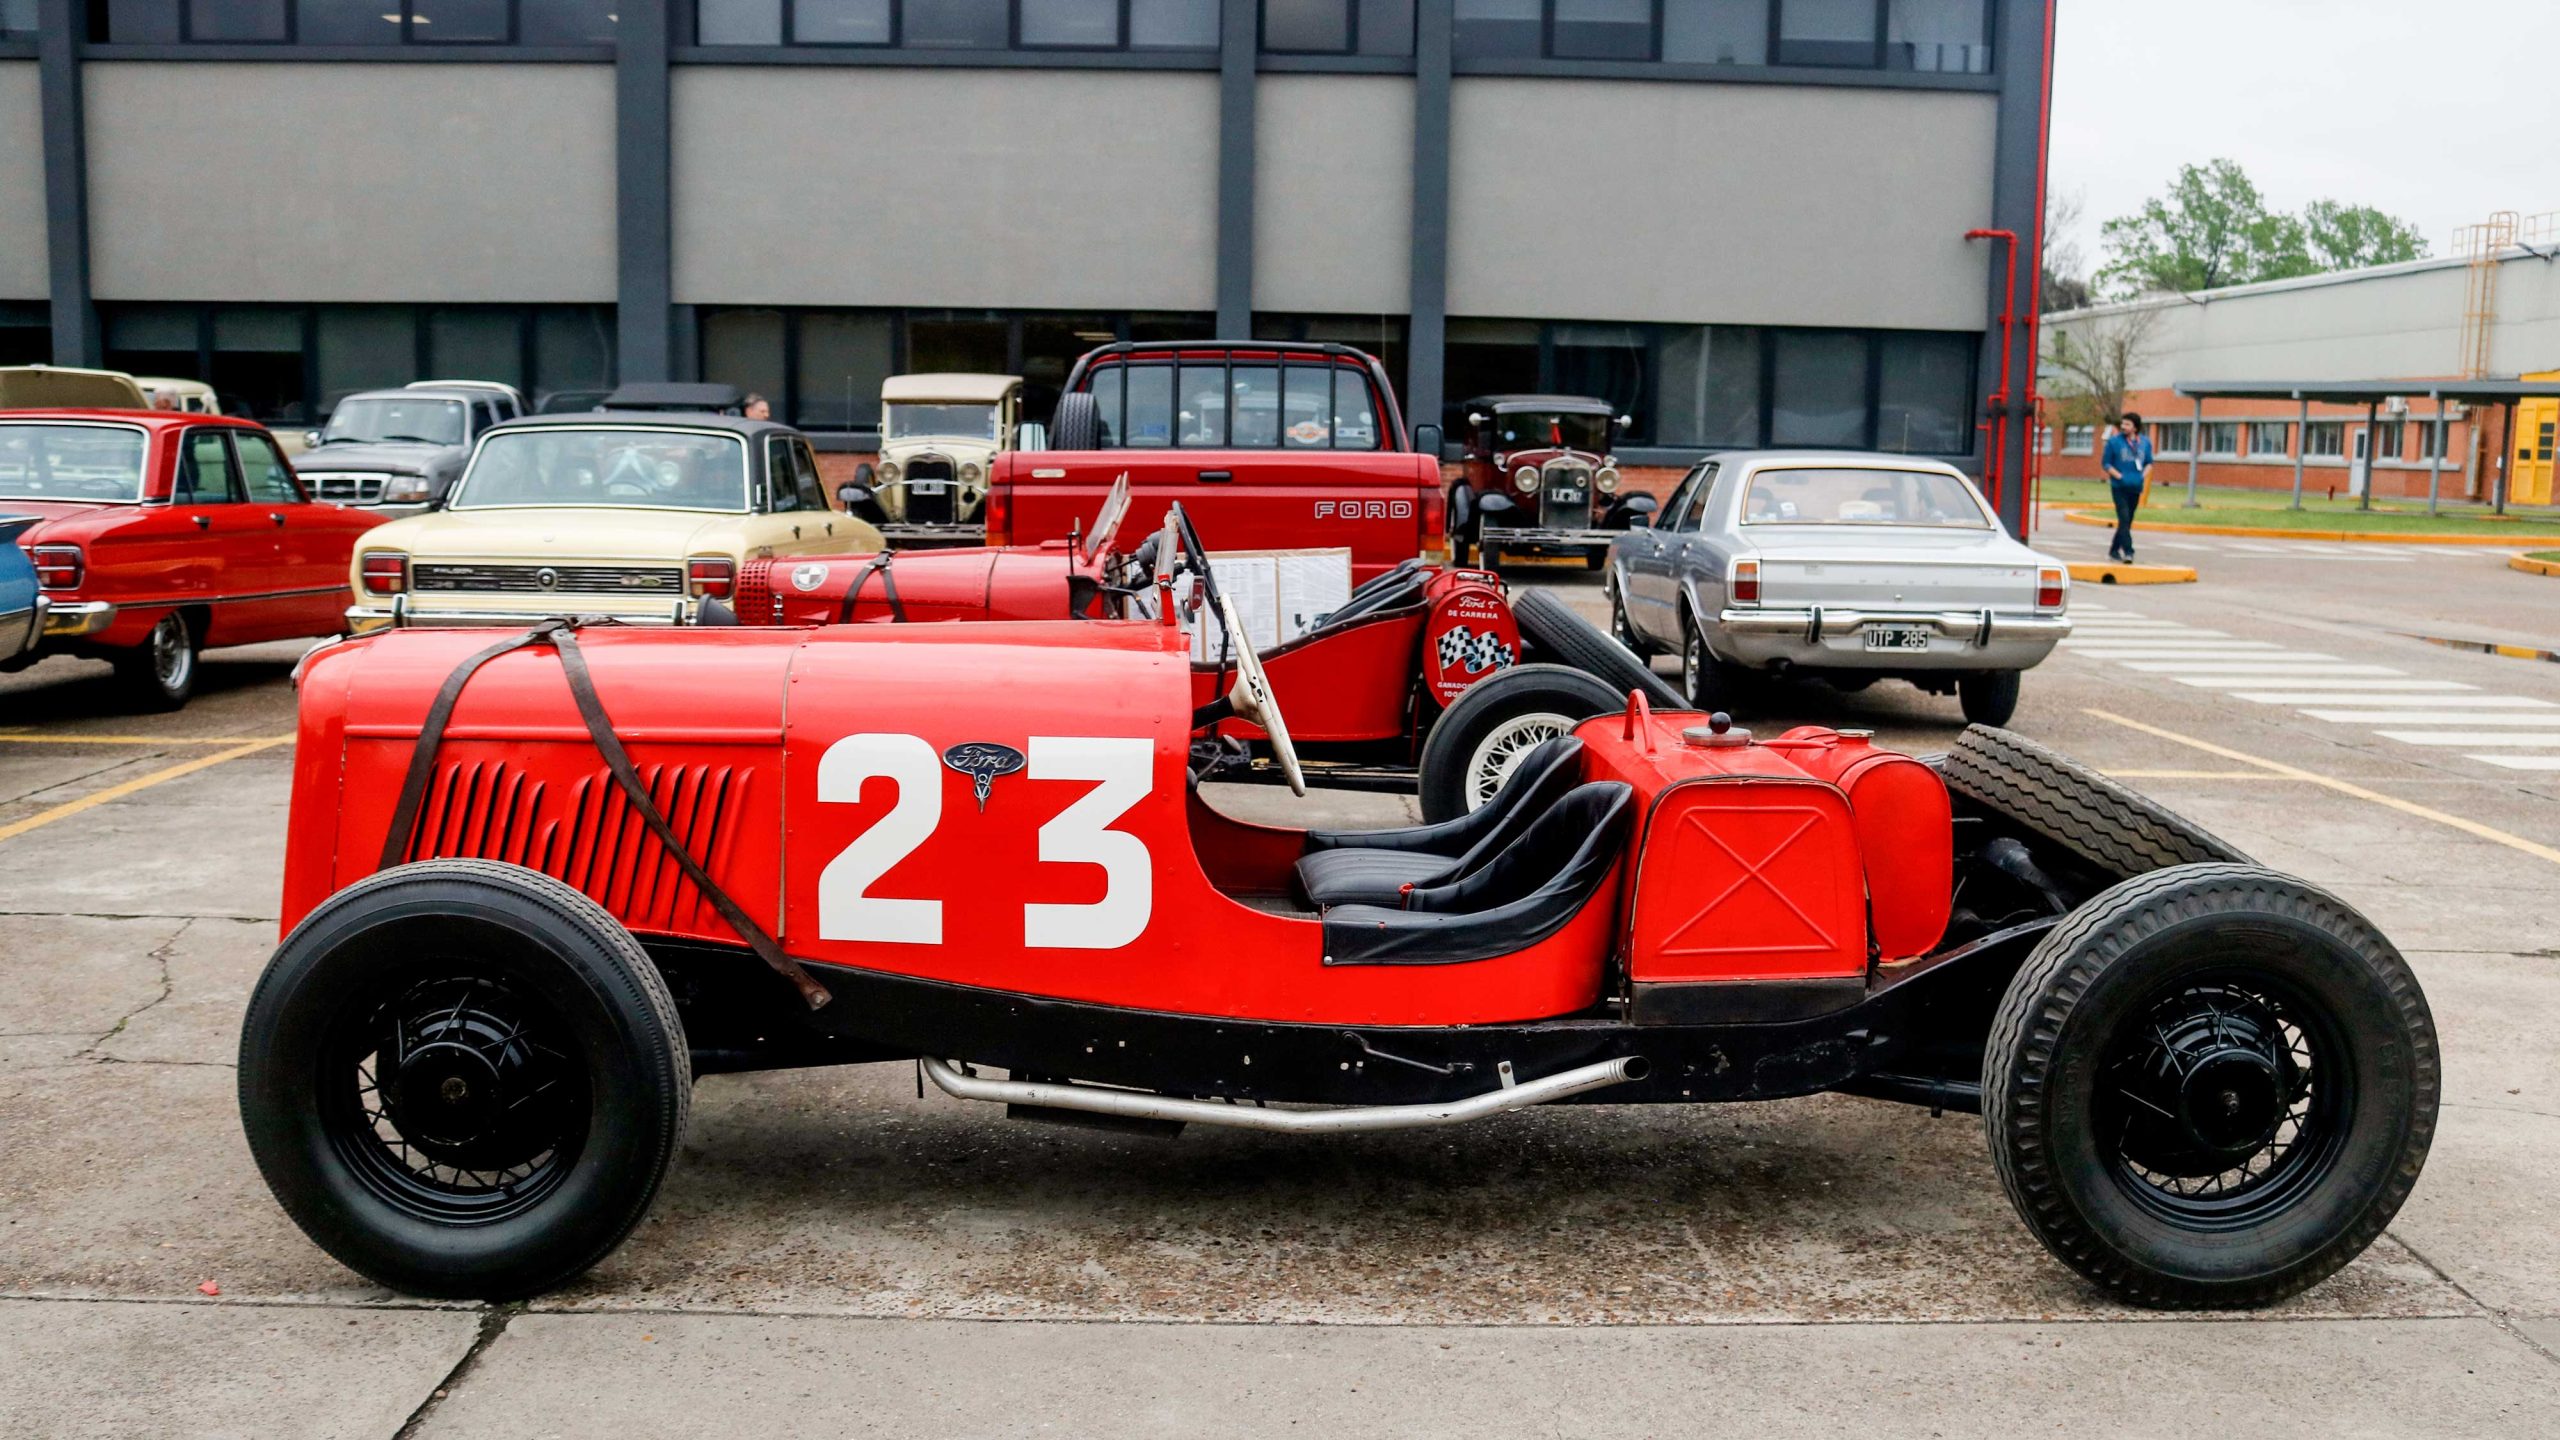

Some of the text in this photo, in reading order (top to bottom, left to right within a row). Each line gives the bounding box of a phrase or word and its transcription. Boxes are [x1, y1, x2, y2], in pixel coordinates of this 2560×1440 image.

[1315, 501, 1412, 519] FORD
[1459, 595, 1486, 608] Ford
[1448, 609, 1498, 619] DE CARRERA
[1868, 630, 1927, 648] UTP 285
[953, 745, 1014, 768] Ford
